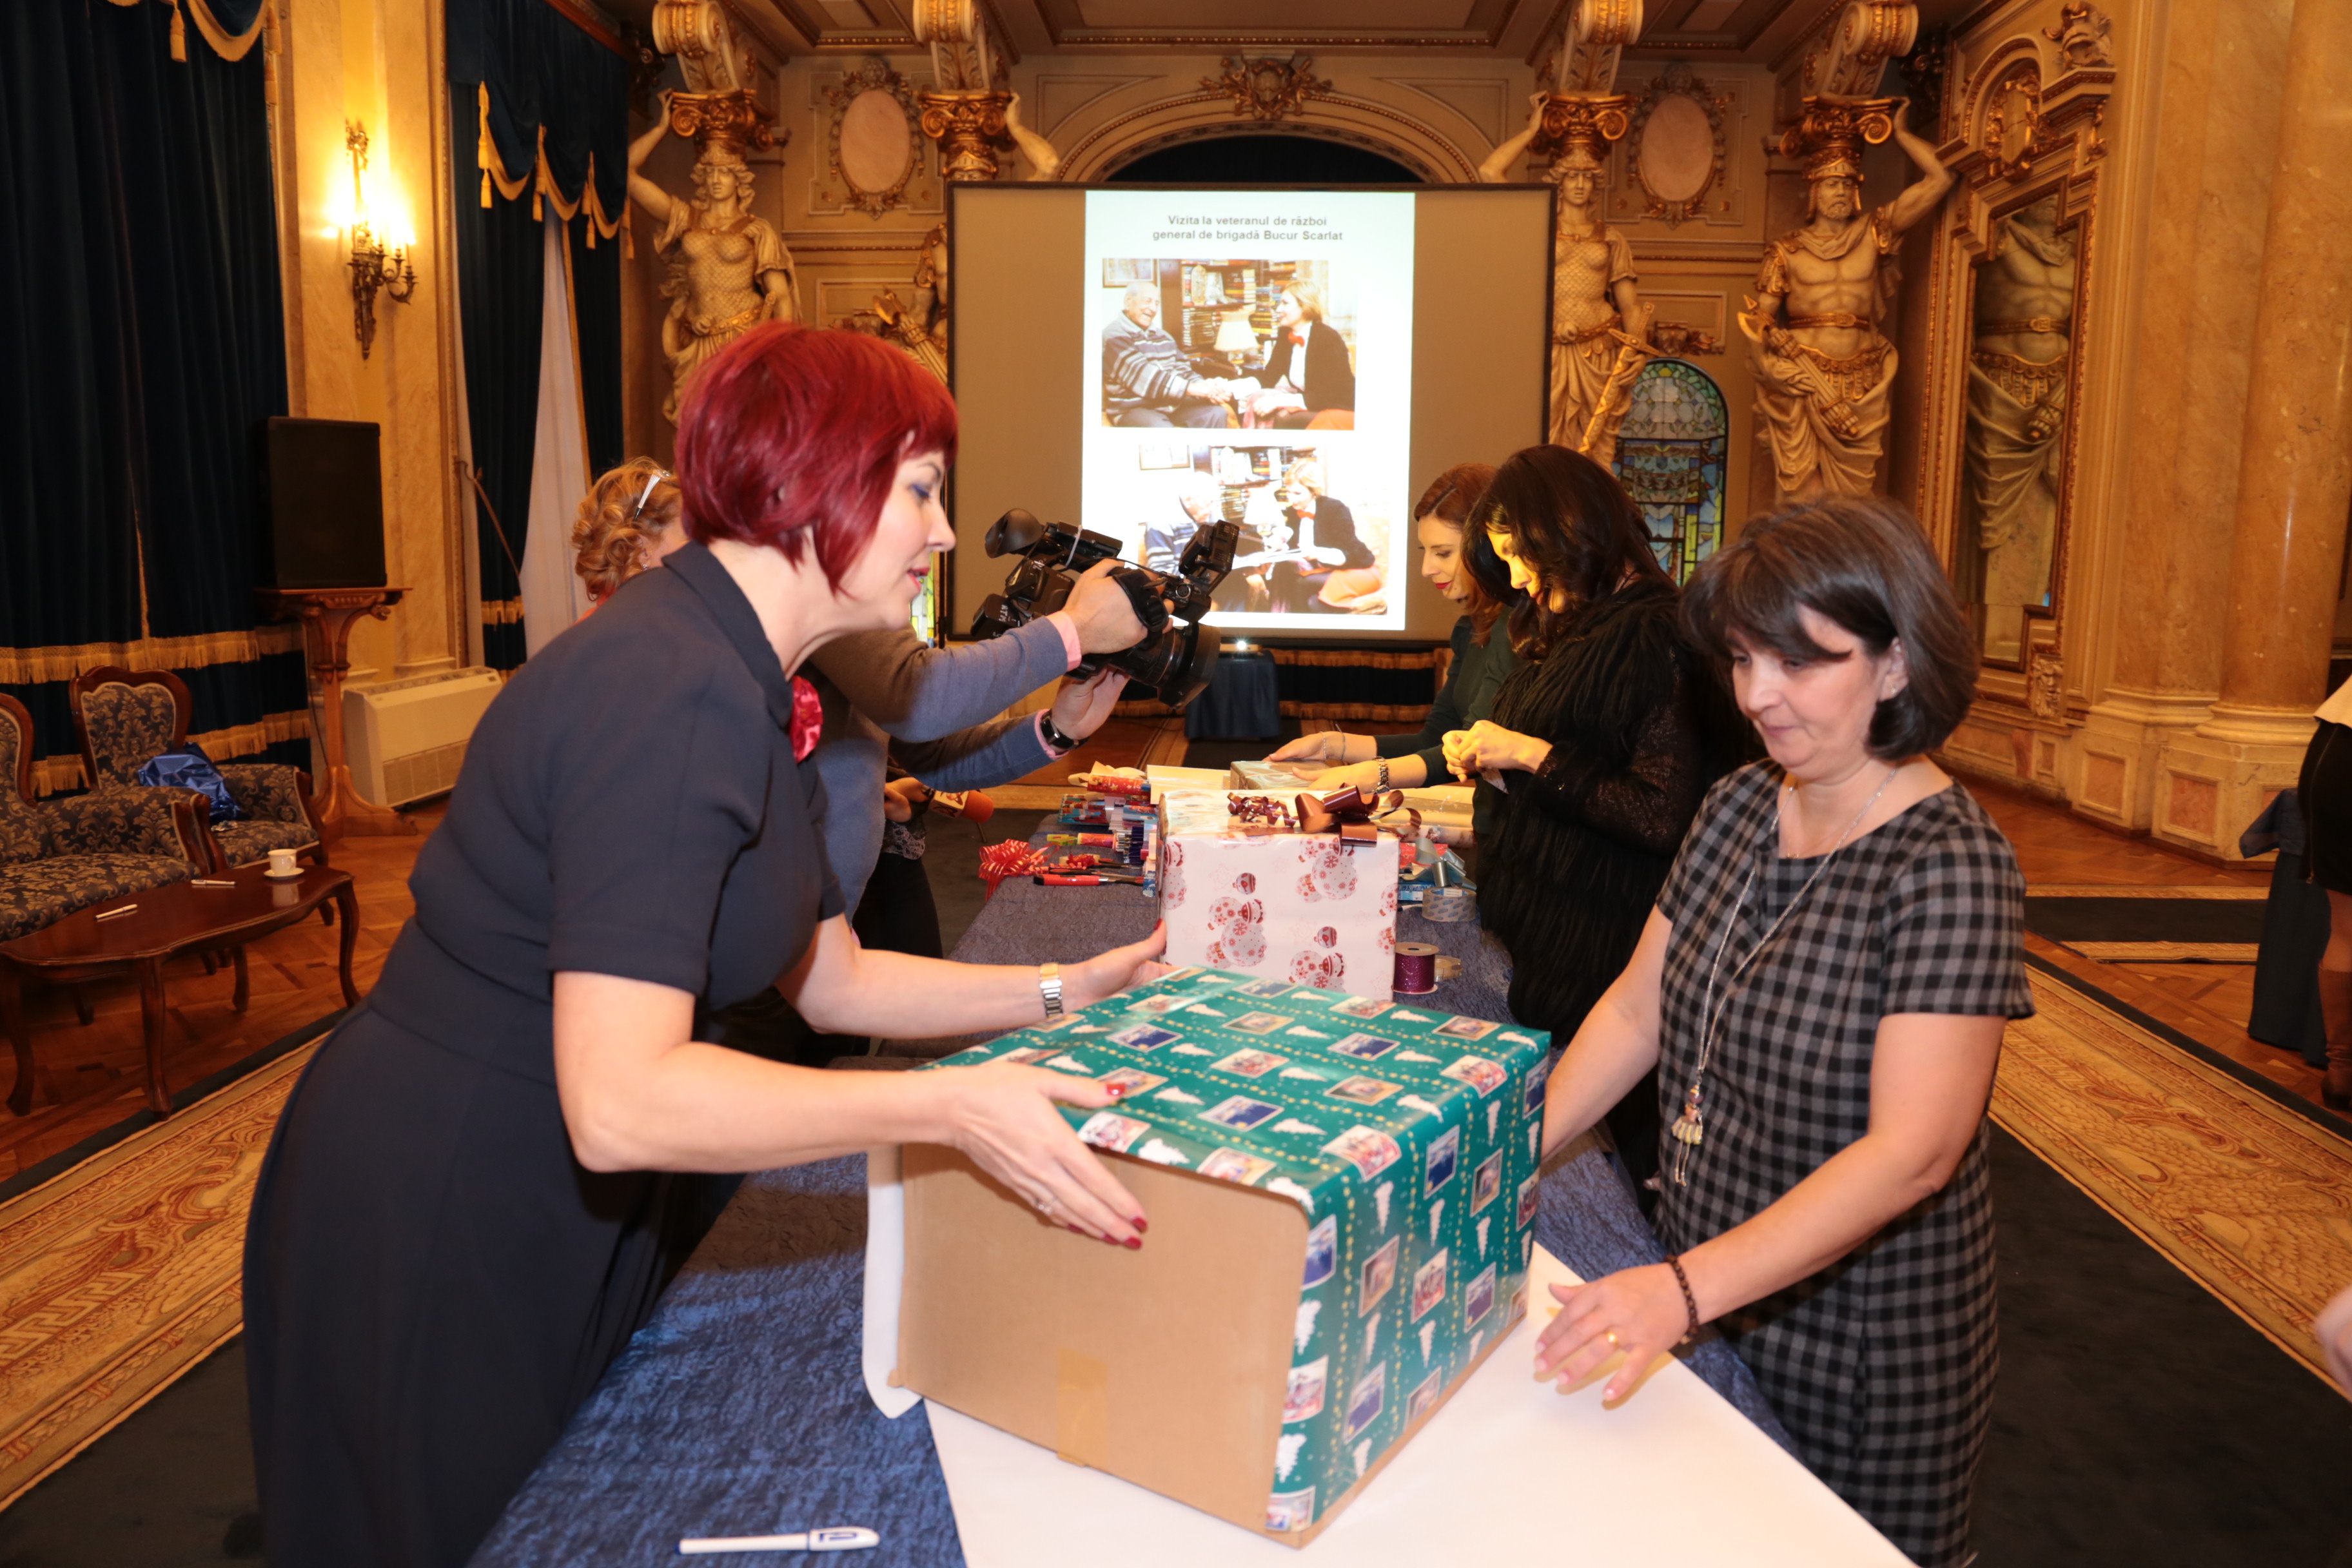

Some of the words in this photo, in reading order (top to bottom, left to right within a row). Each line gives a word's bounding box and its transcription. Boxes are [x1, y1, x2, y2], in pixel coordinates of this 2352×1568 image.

[1168, 215, 1199, 225] Vizita
[1202, 216, 1212, 225] la
[1216, 217, 1269, 225] veteranul
[1273, 217, 1287, 226] de
[1291, 216, 1327, 226] război
[1153, 230, 1195, 241] general
[1199, 230, 1212, 239] de
[1217, 230, 1260, 242] brigadă
[1264, 230, 1298, 240] Bucur
[1302, 231, 1342, 240] Scarlat
